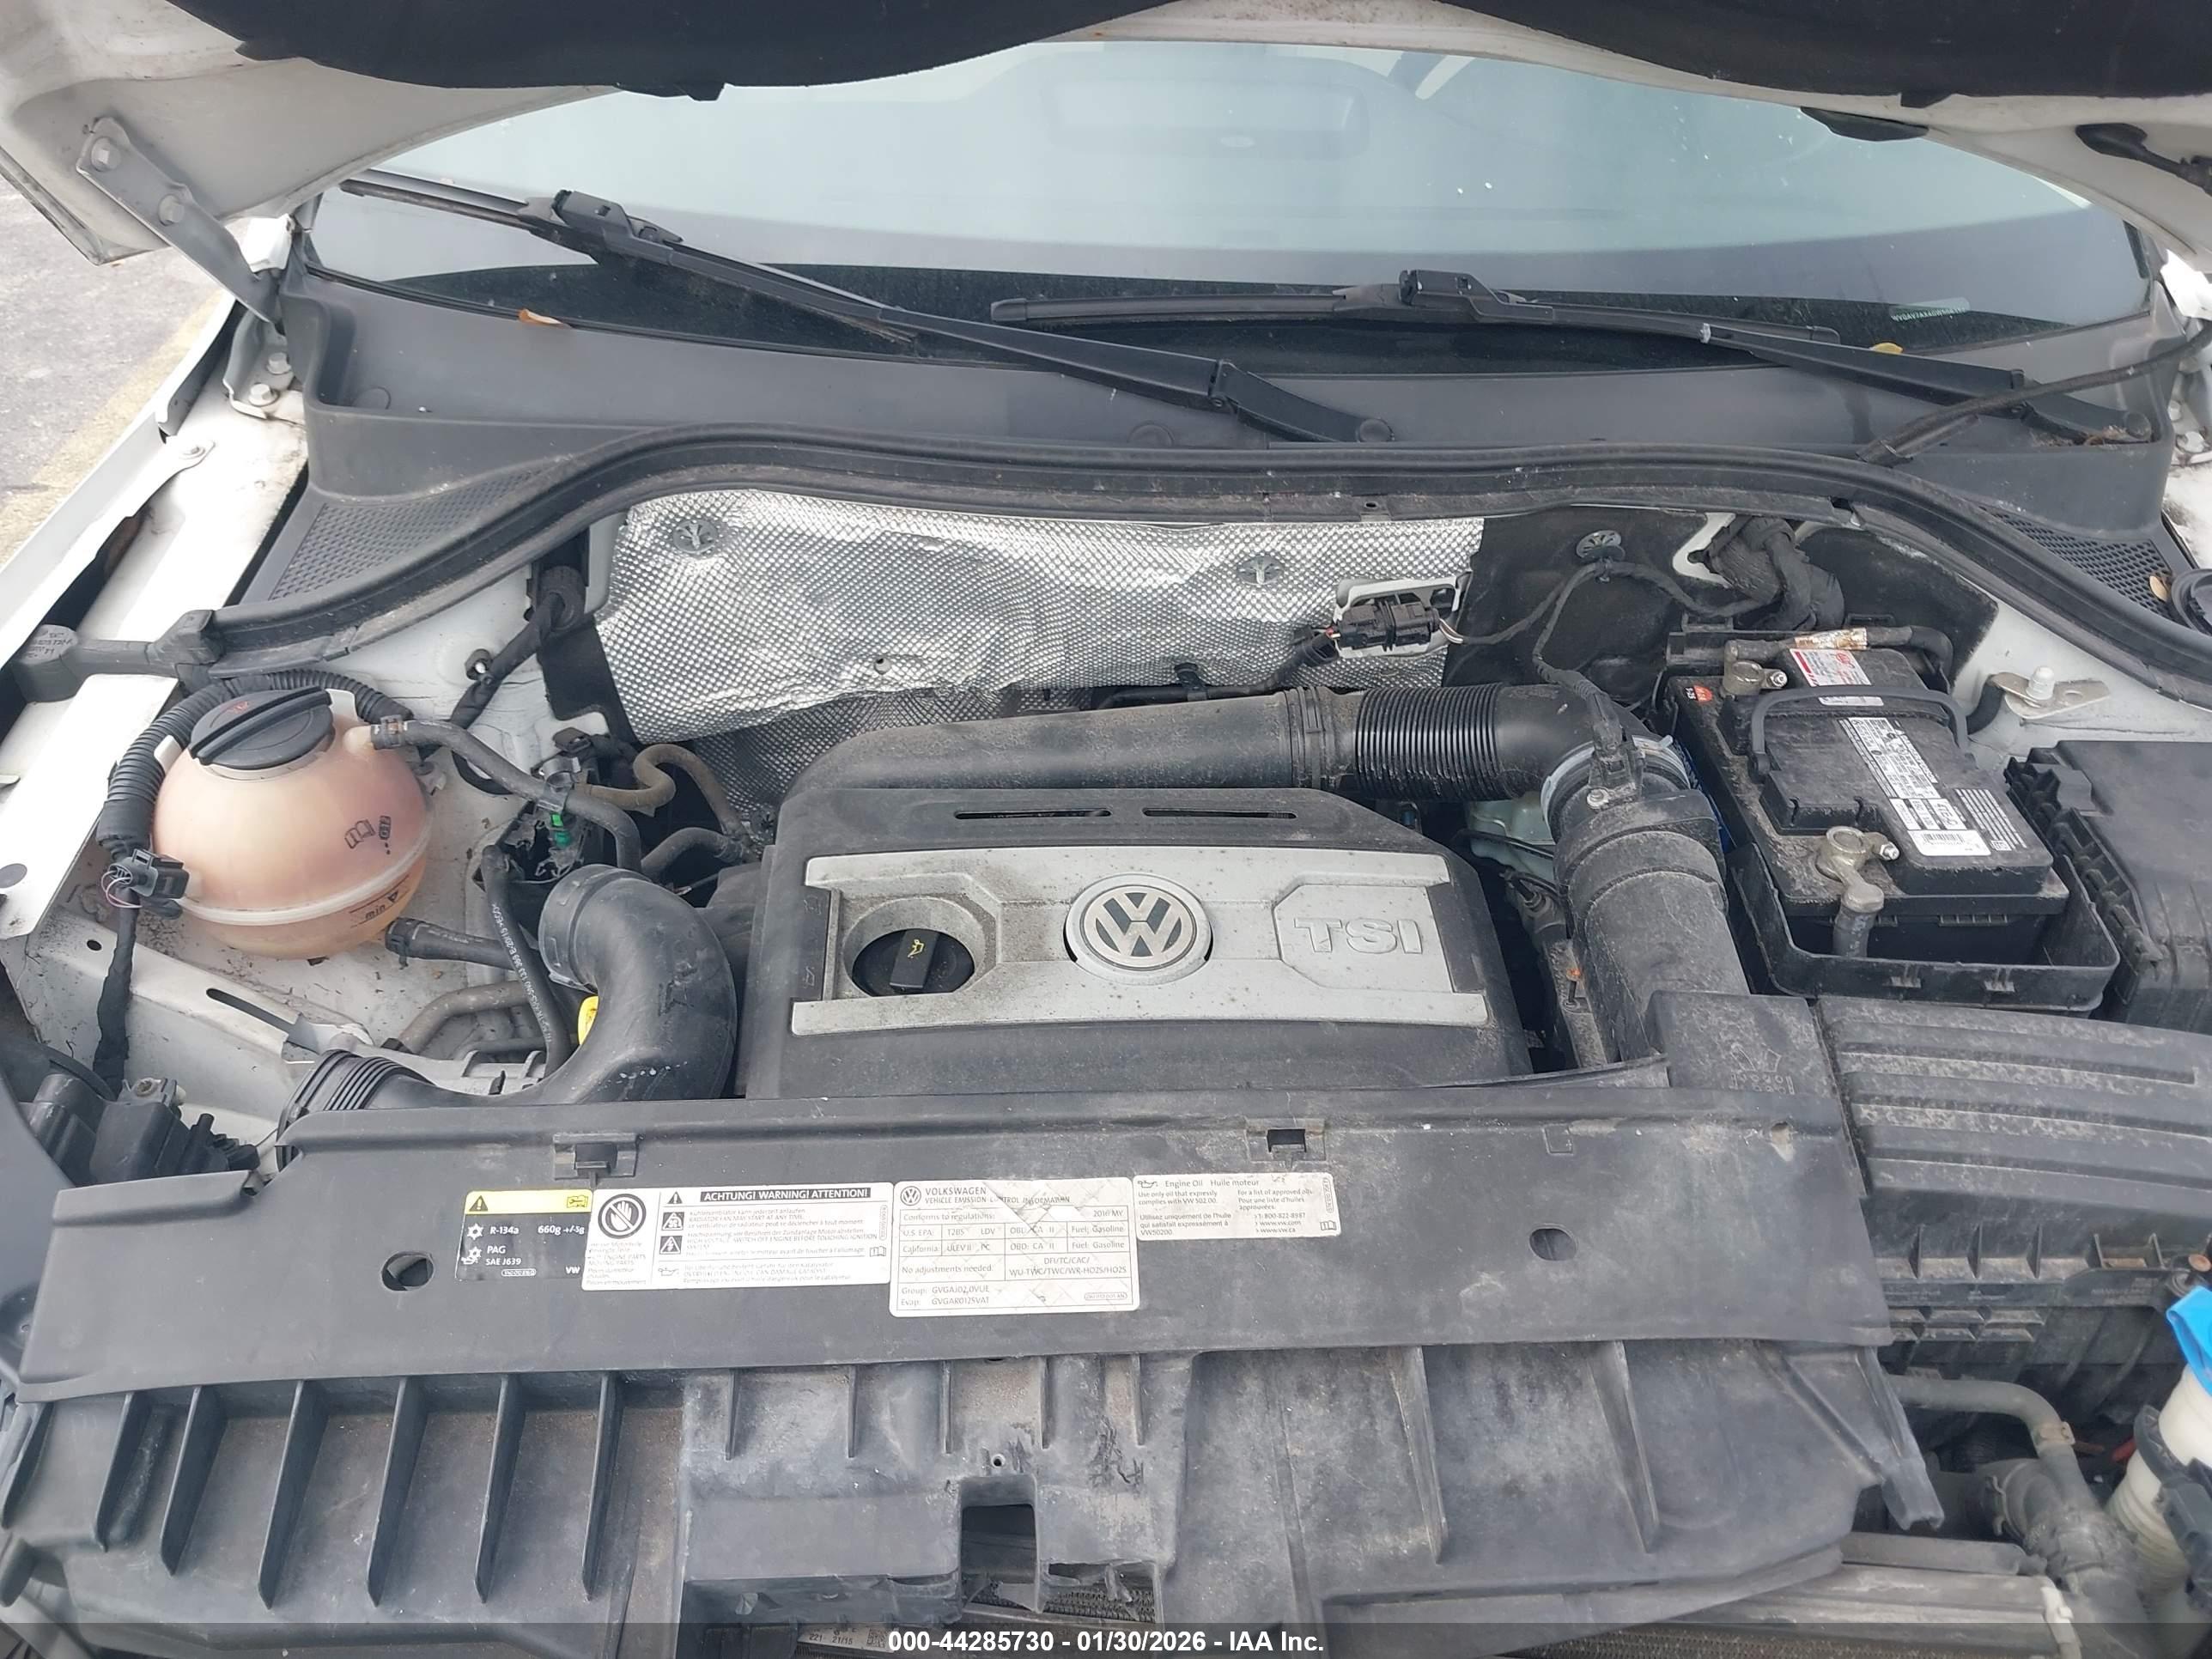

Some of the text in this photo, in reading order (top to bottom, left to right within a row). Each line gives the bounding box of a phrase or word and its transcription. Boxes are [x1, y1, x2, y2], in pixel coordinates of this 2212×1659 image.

[365, 904, 386, 921] min
[1293, 917, 1424, 955] TSI
[704, 1188, 868, 1201] ACHTUNG! WARNING! ATTENTION!
[926, 1187, 987, 1195] VOLKSWAGEN
[1273, 1188, 1301, 1197] approved
[951, 1212, 995, 1223] regulations:
[489, 1225, 520, 1235] R-134a
[538, 1224, 561, 1236] 660g
[1092, 1224, 1124, 1234] Gasoline
[487, 1245, 506, 1254] PAG
[1093, 1241, 1125, 1249] Gasoline
[485, 1257, 522, 1266] SAE J639
[915, 1265, 962, 1275] adjustments
[902, 1286, 927, 1296] Group:
[832, 1636, 853, 1645] 21/15
